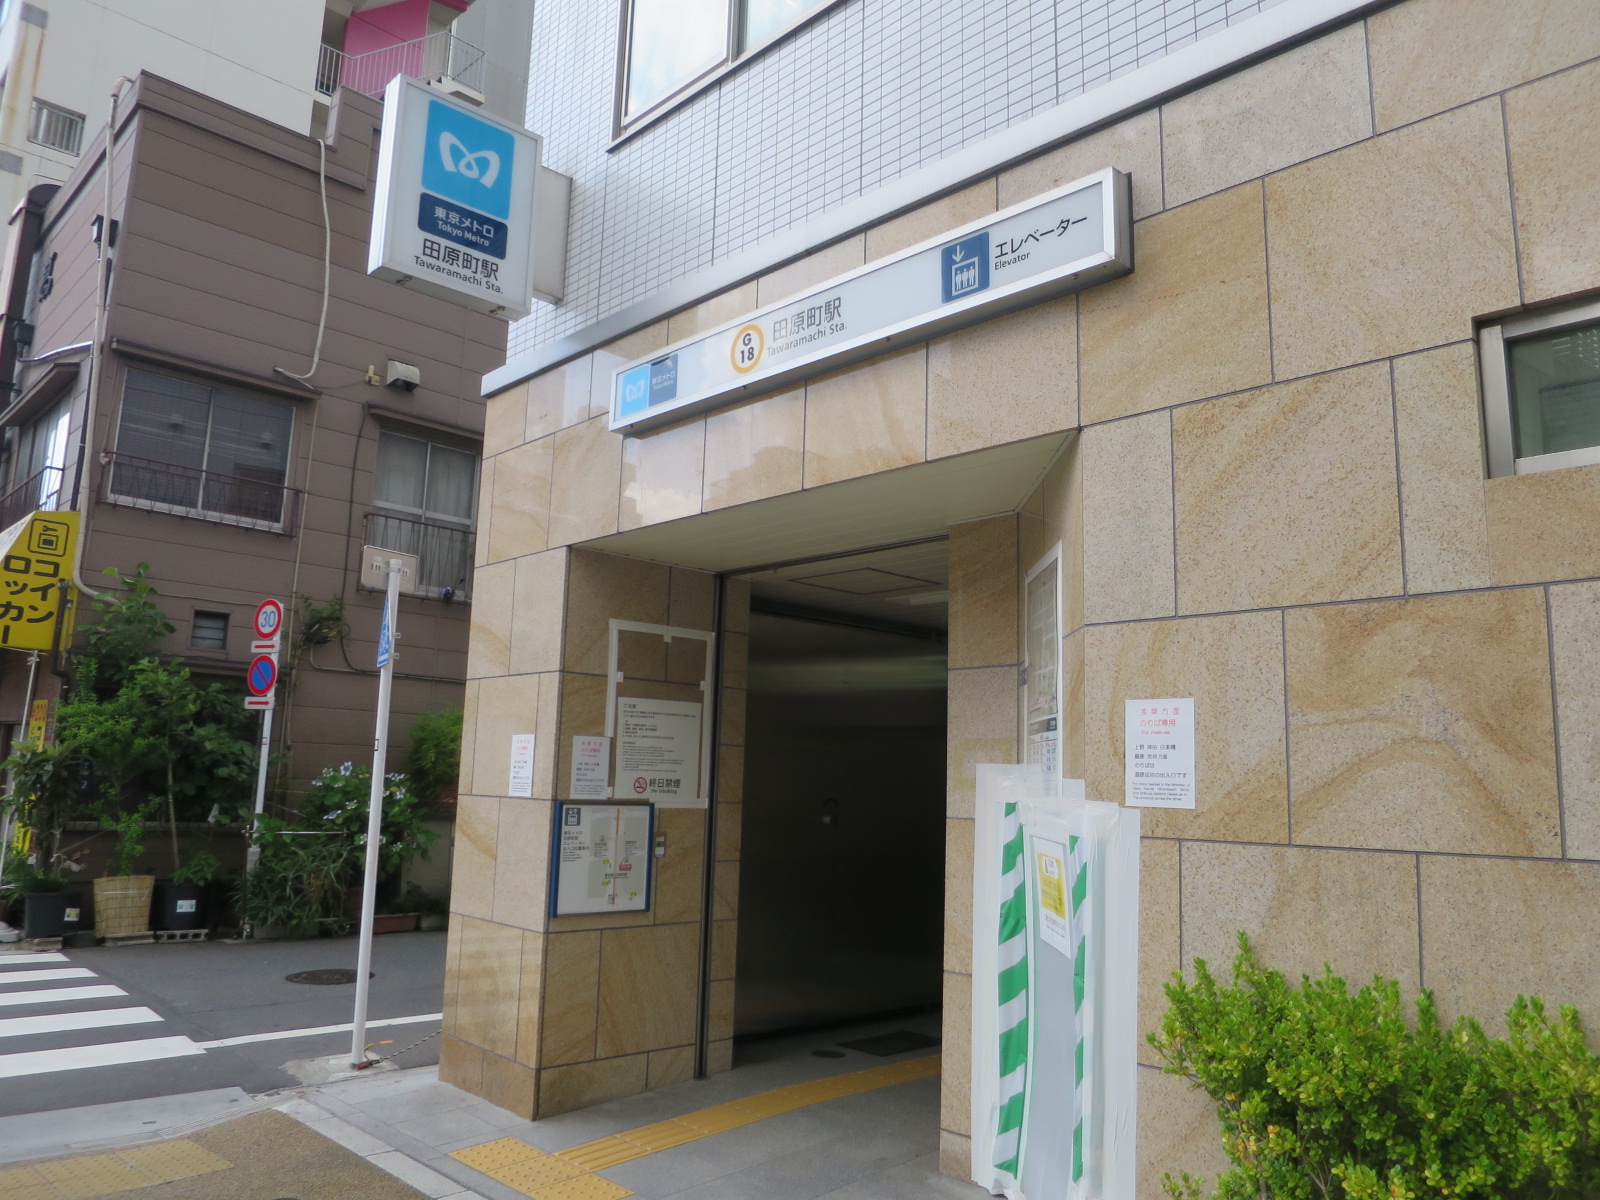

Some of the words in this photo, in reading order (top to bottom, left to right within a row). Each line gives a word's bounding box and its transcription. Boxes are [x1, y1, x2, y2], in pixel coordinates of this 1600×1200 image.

[434, 206, 494, 238] 東京メトロ
[437, 220, 463, 237] Tokyo
[464, 231, 490, 247] Metro
[995, 217, 1088, 259] エレベーター
[414, 255, 482, 287] Tawaramachi
[485, 280, 504, 295] Sta.
[423, 238, 499, 281] 田原町駅
[994, 252, 1031, 271] Elevator
[773, 297, 842, 343] 田原町駅
[740, 346, 755, 364] 18
[742, 332, 753, 347] G
[767, 328, 827, 358] Tawaramachi
[829, 322, 849, 335] Sta.
[27, 559, 60, 624] コイン
[260, 610, 277, 628] 30
[649, 778, 681, 789] 終日禁煙
